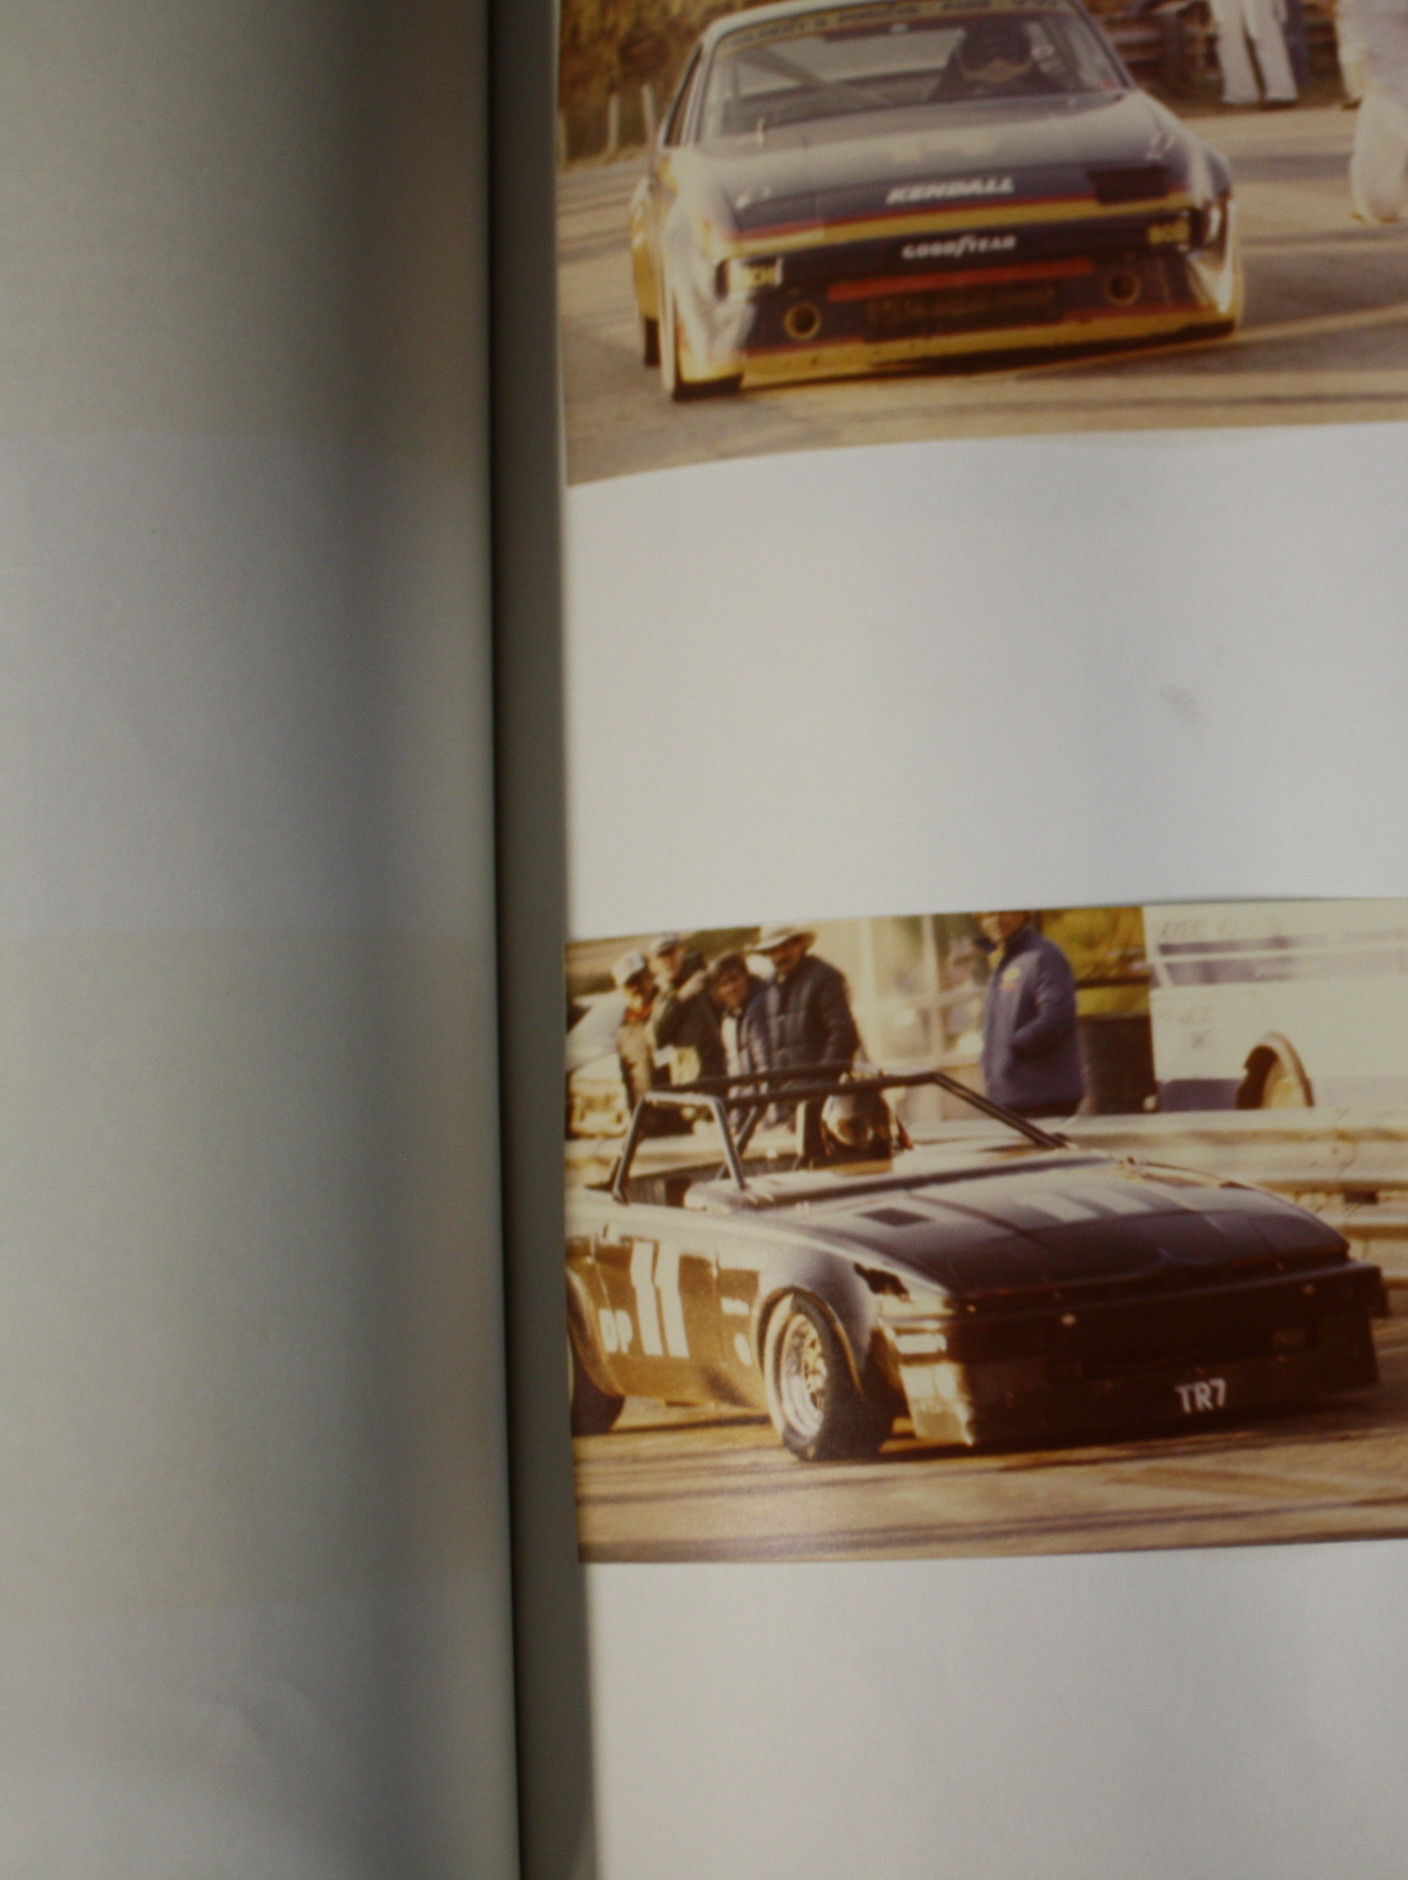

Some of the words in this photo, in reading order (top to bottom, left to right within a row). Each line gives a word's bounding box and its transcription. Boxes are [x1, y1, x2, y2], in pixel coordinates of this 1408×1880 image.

[886, 176, 1015, 206] KENDALL
[901, 234, 1018, 260] GOODYEAR
[629, 1240, 690, 1359] 11
[1174, 1378, 1226, 1414] TR7
